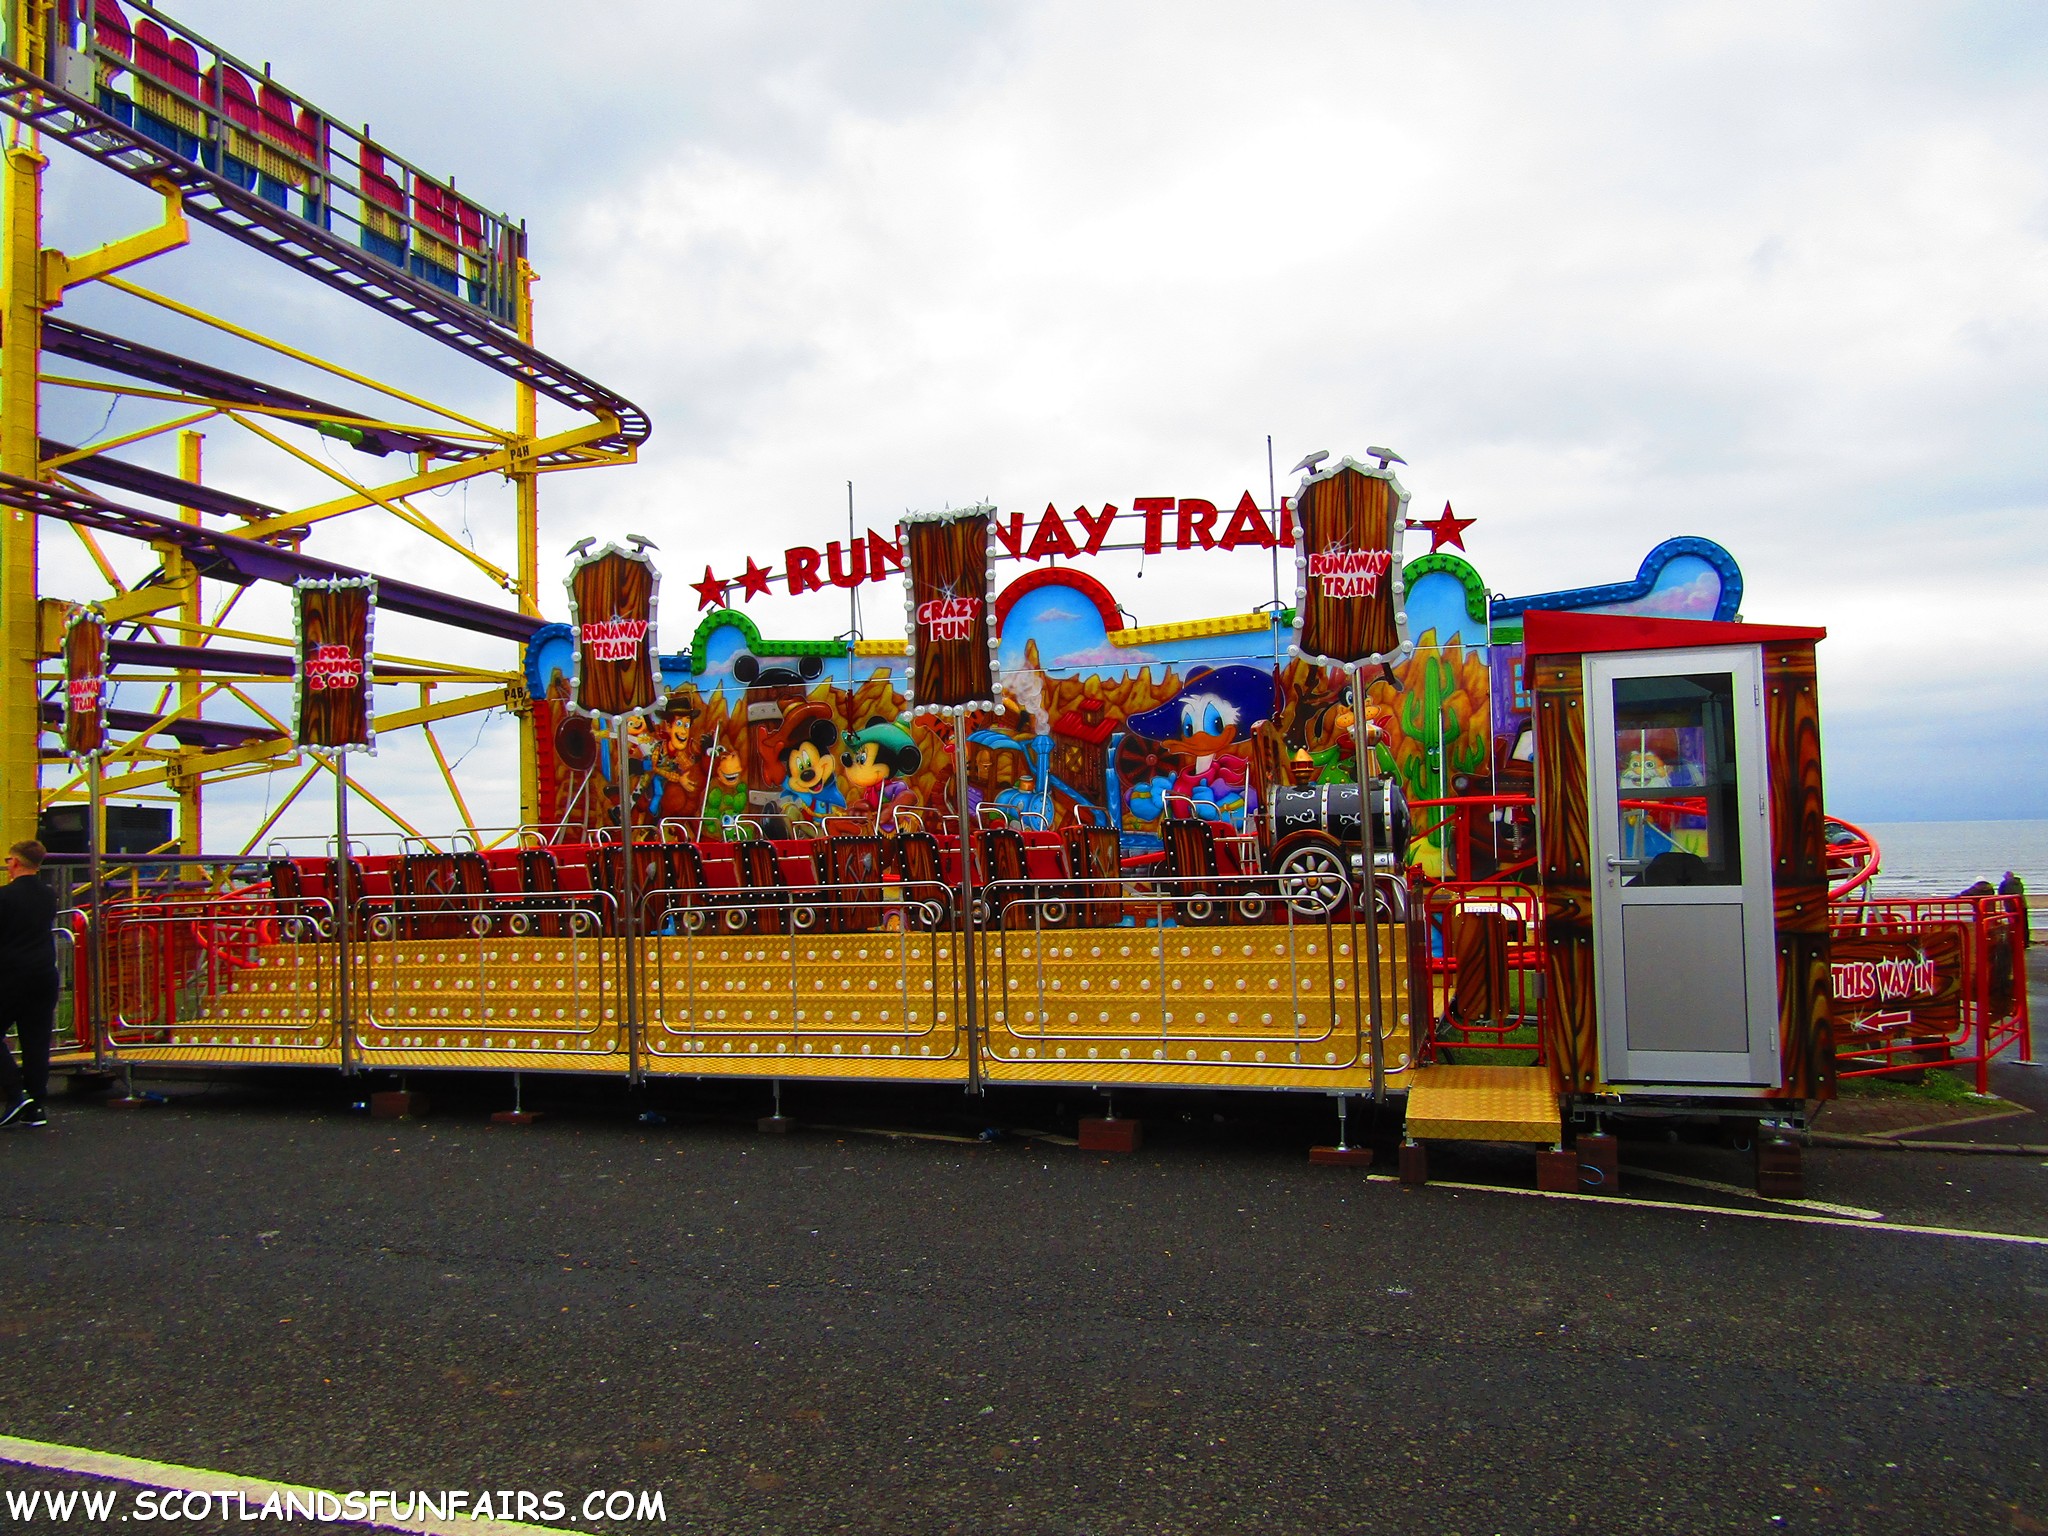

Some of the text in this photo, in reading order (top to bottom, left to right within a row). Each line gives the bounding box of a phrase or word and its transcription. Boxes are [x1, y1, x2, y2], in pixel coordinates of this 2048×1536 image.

[510, 445, 530, 461] P4H
[785, 490, 1298, 596] RUNAY TRAI
[1309, 549, 1391, 577] RUNAWAY
[1322, 575, 1376, 600] TRAIN
[916, 597, 983, 625] CRAZY
[582, 619, 648, 643] RUNAWAY
[930, 619, 970, 642] FUN
[319, 645, 350, 661] FOR
[593, 641, 637, 662] TRAIN
[305, 659, 363, 677] YOUNG
[309, 674, 359, 690] & OLD
[504, 687, 524, 702] P4B
[1831, 956, 1934, 1001] THIS WAY IN
